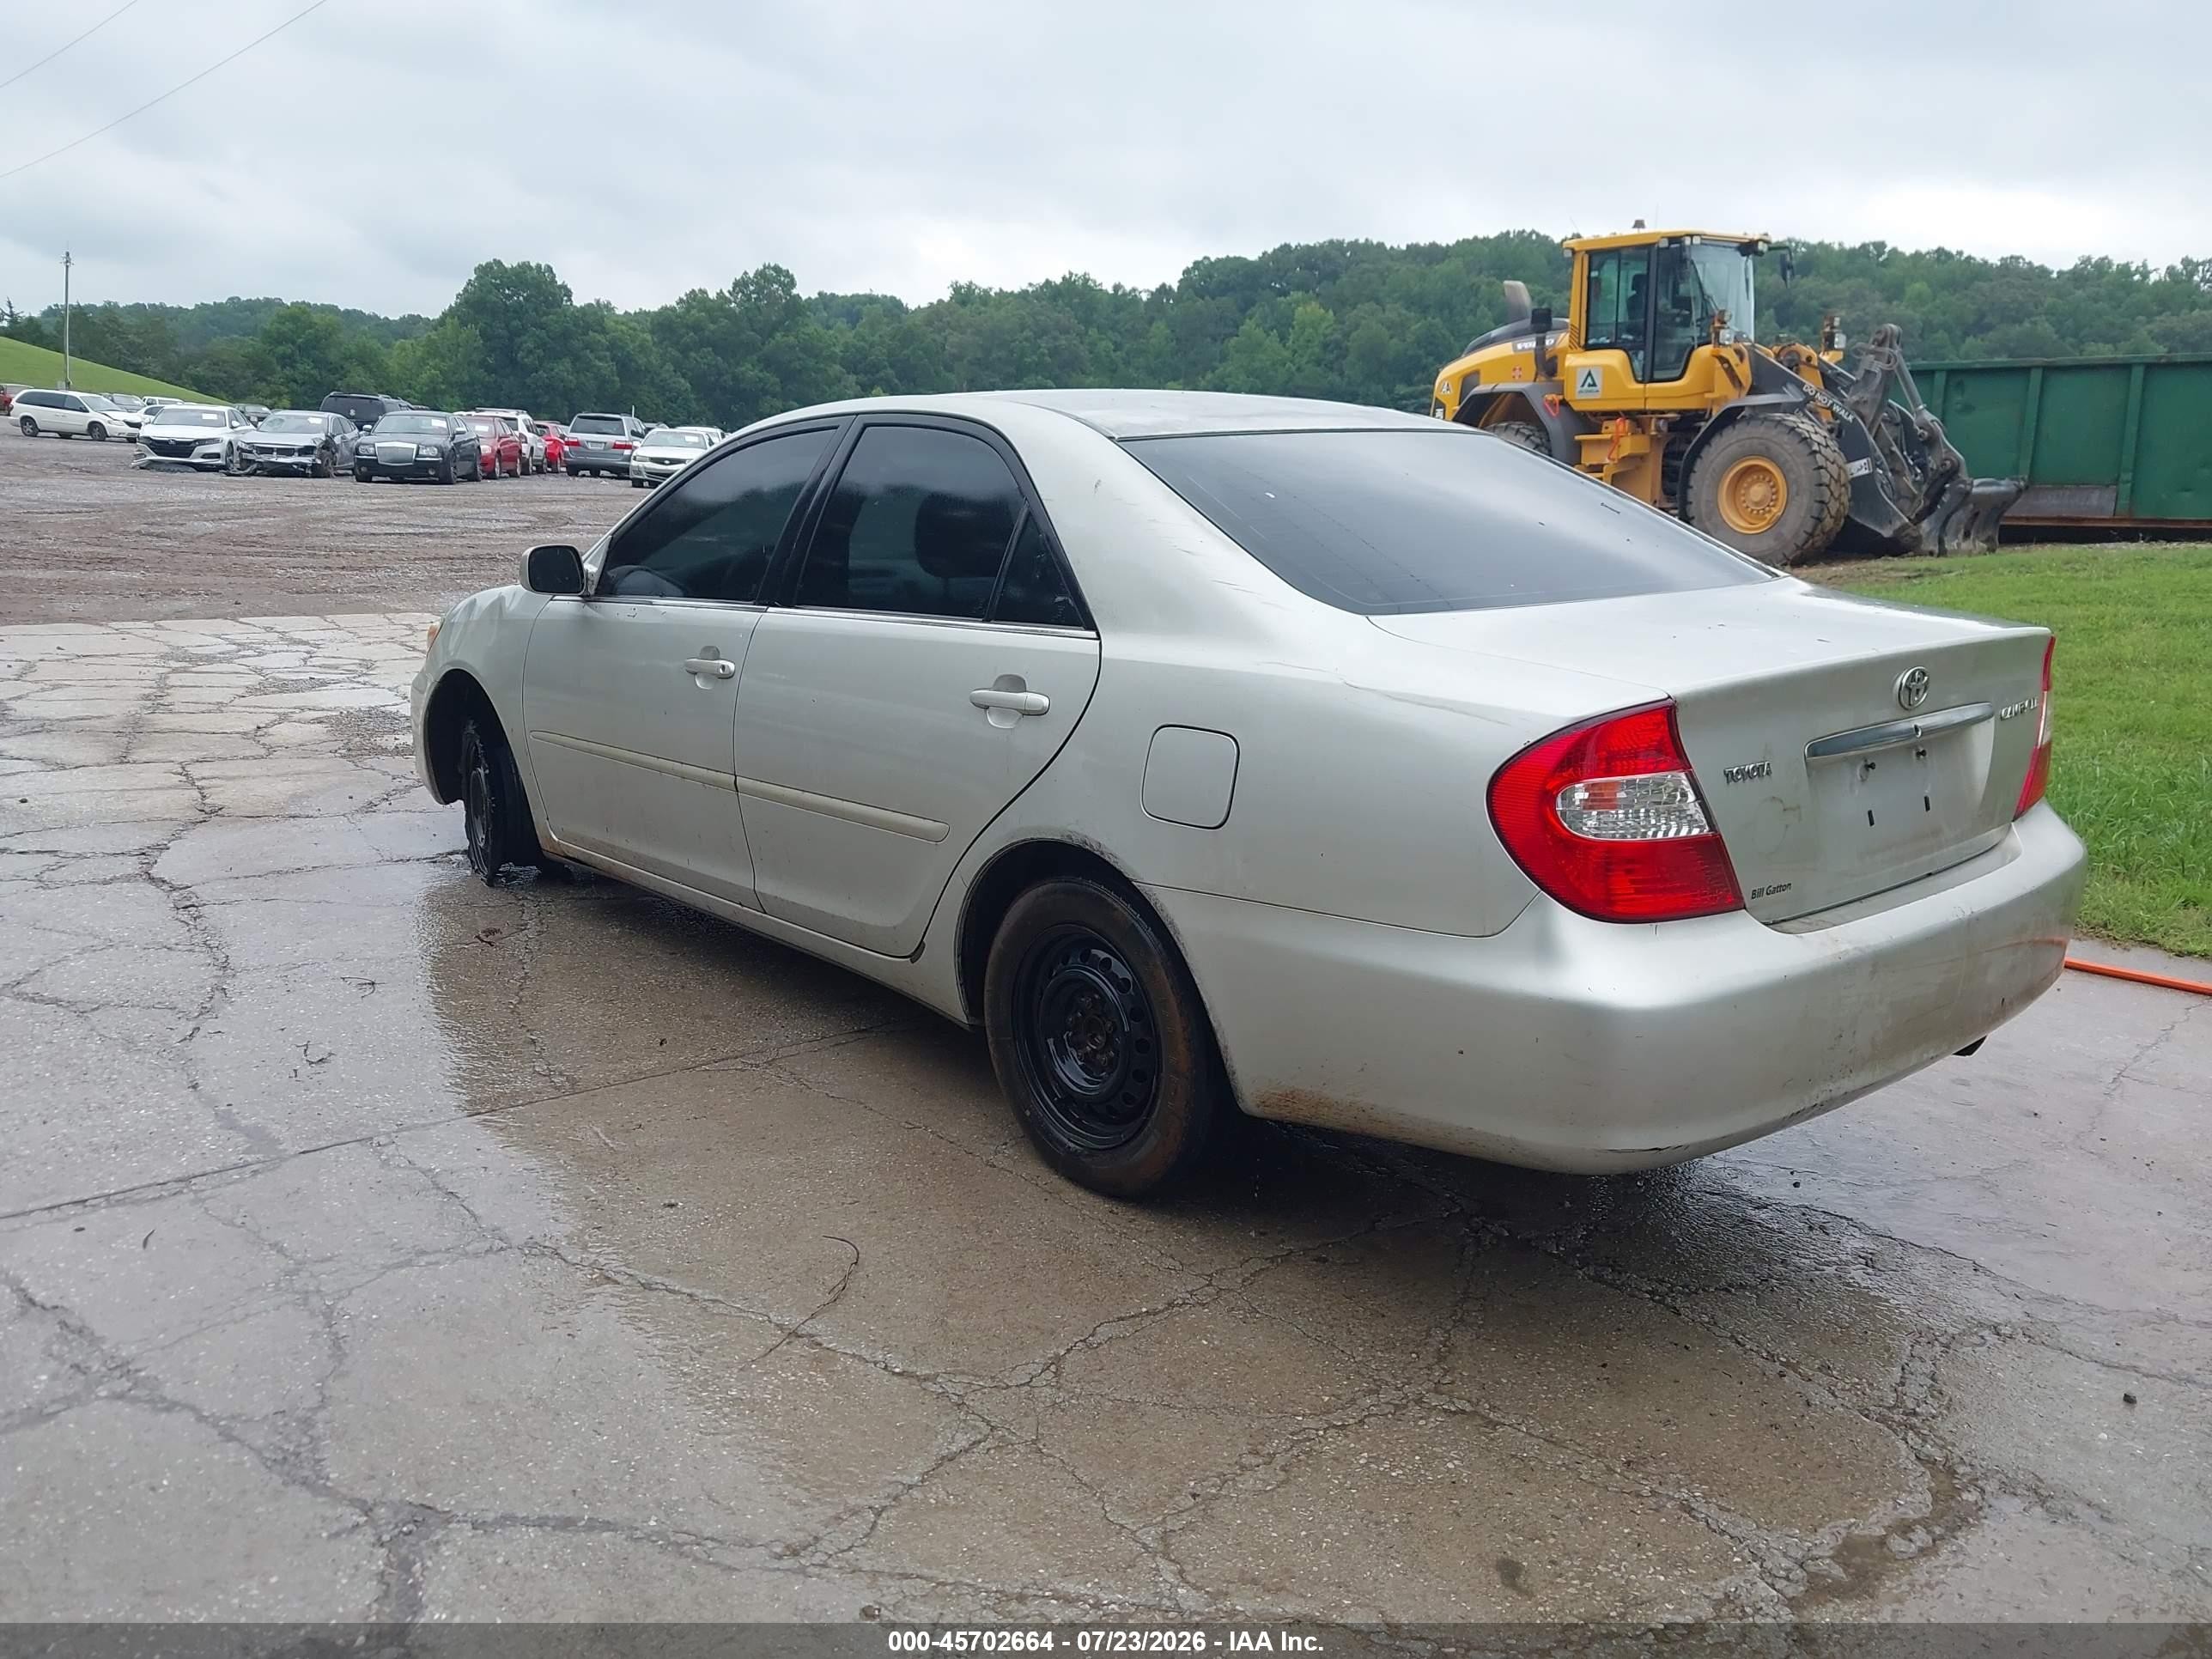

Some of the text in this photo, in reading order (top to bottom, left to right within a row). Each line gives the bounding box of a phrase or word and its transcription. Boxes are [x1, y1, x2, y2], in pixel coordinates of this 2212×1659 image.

[1516, 337, 1555, 350] VOLO
[1802, 384, 1854, 423] DO NOT WALK
[1723, 761, 1772, 783] TOYOTA
[1751, 883, 1792, 900] Bill Gatton
